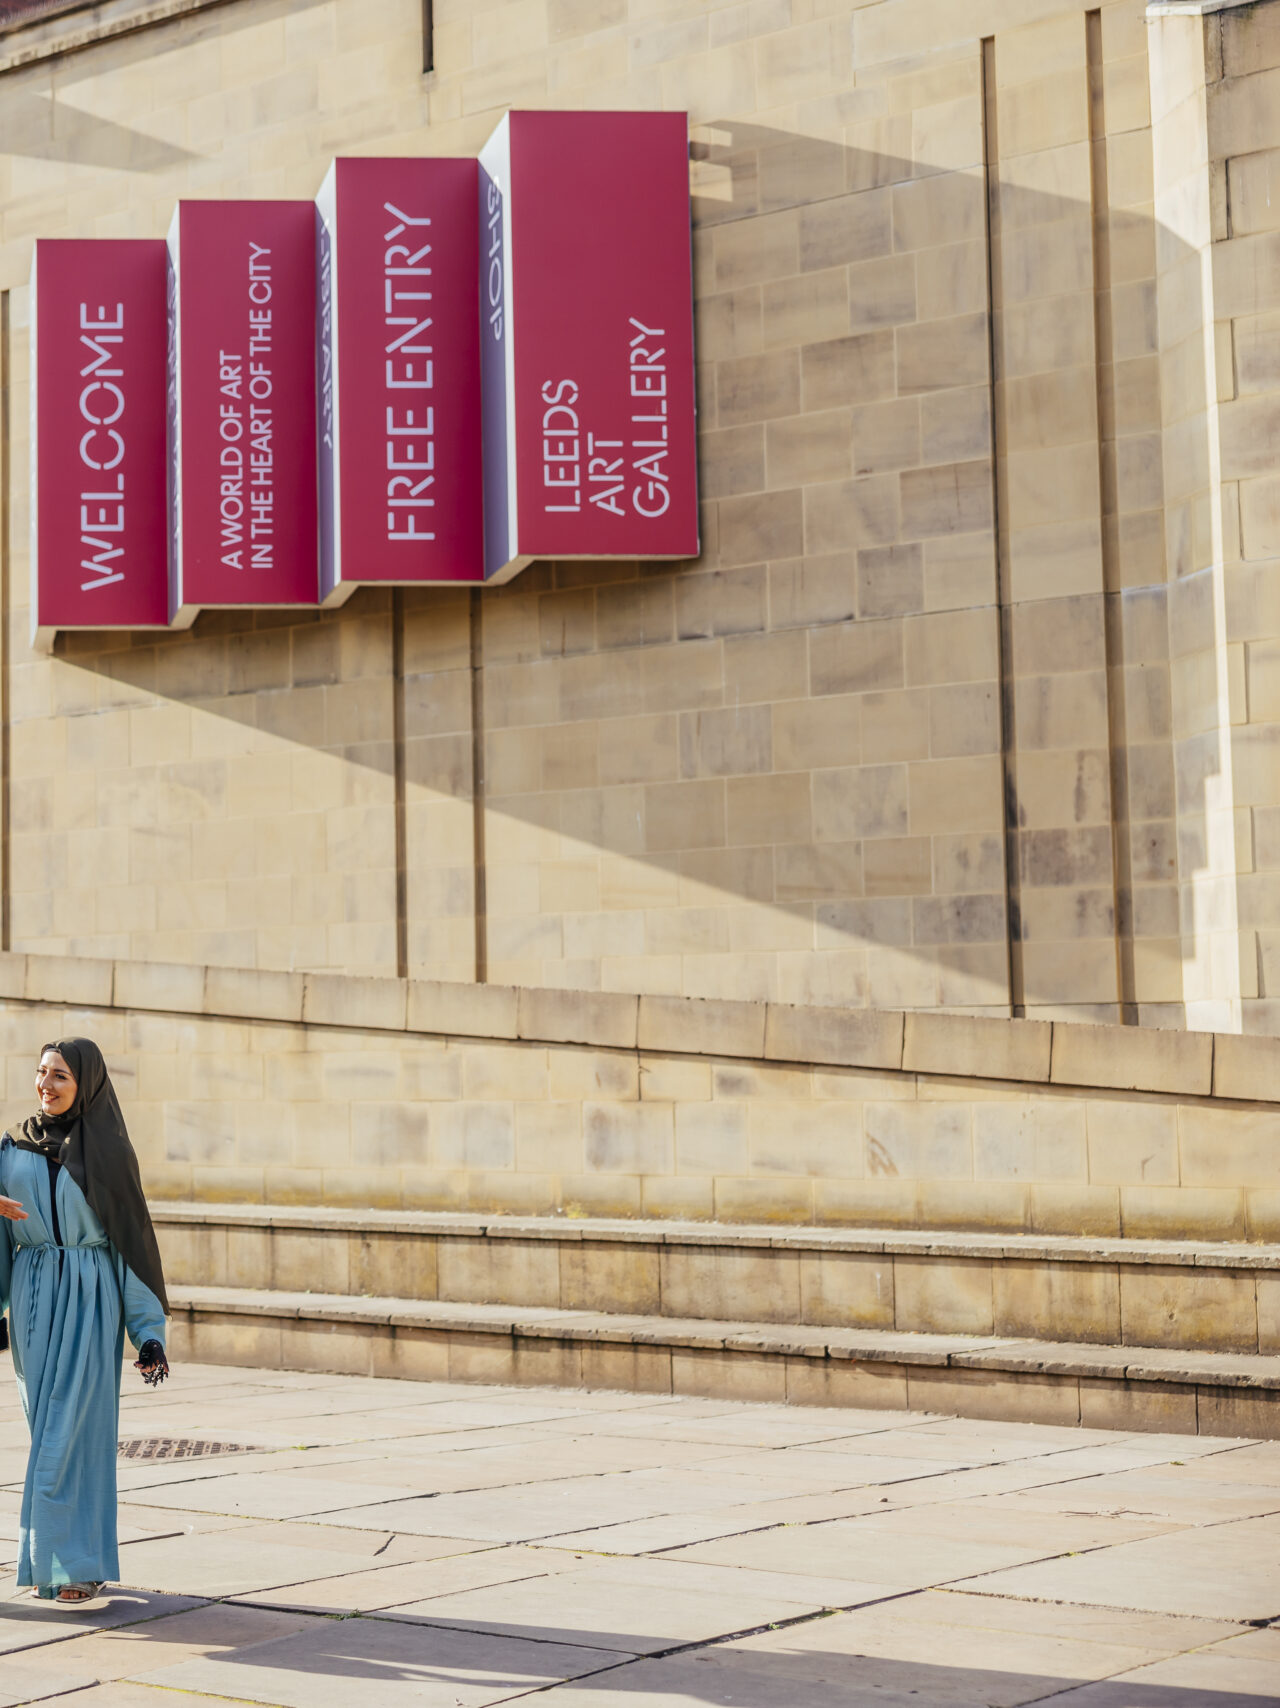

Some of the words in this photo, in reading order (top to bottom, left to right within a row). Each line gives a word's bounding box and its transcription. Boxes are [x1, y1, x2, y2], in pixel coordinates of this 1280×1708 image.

[248, 241, 272, 304] CITY
[383, 202, 433, 389] ENTRY
[487, 175, 503, 341] SHOP
[249, 309, 272, 357] THE
[219, 349, 242, 400] ART
[249, 362, 273, 399] OF
[79, 302, 125, 591] WELCOME
[219, 404, 243, 442] OF
[249, 403, 273, 485] HEART
[541, 379, 581, 512] LEEDS
[628, 317, 670, 518] GALLERY
[220, 446, 244, 547] WORLD
[386, 406, 435, 540] FREE
[587, 431, 626, 516] ART
[250, 491, 273, 539] THE
[220, 550, 243, 570] A
[250, 544, 273, 569] IN
